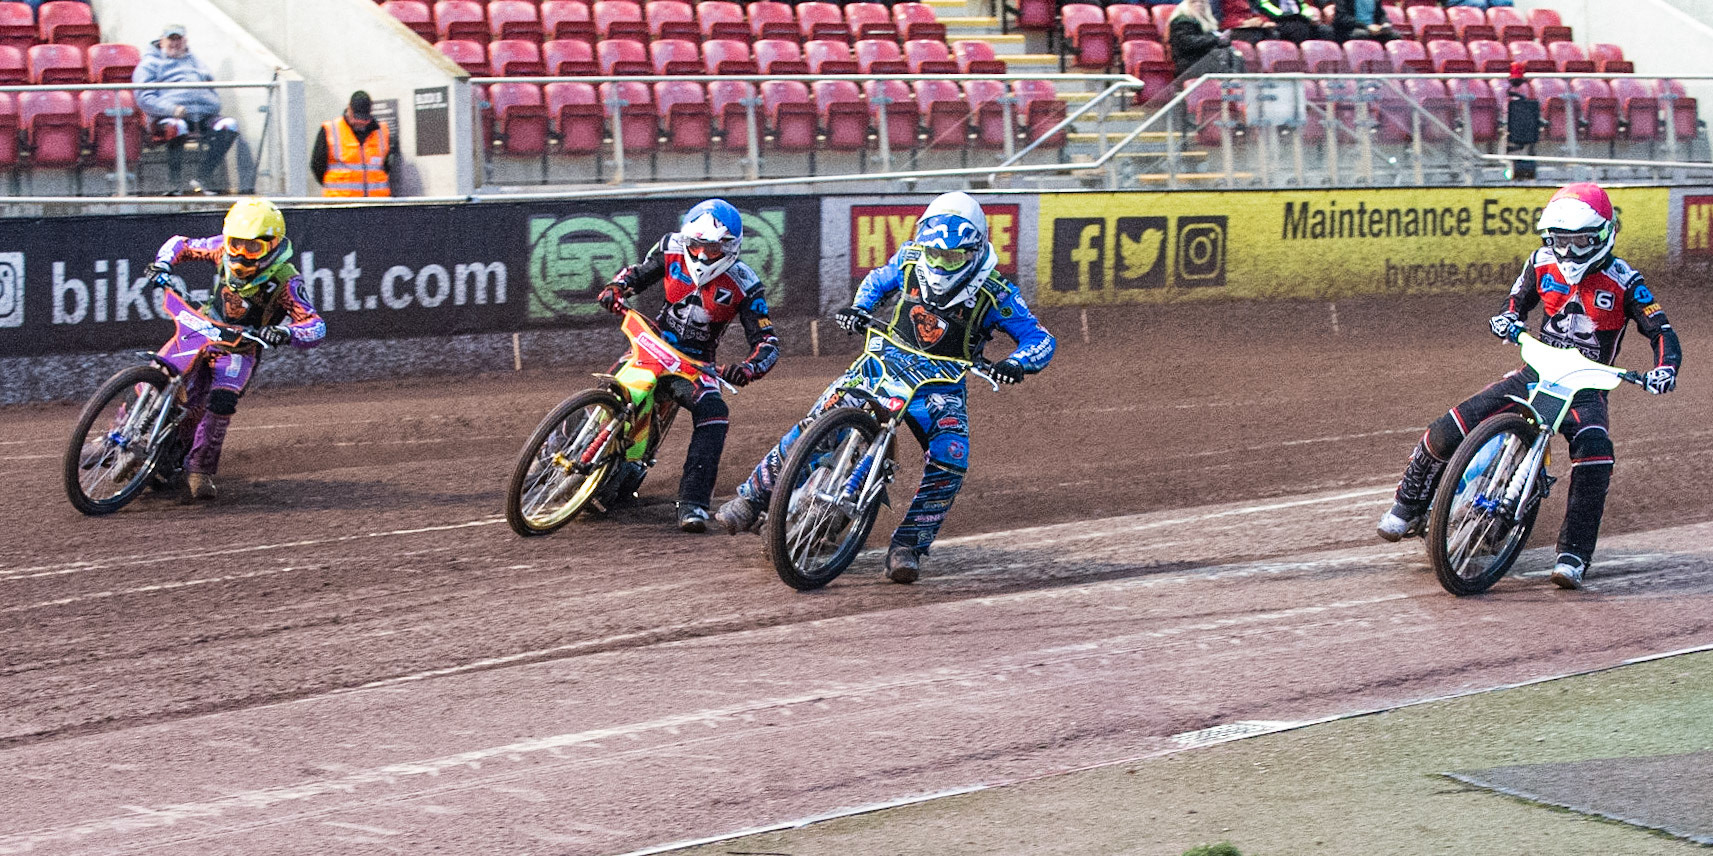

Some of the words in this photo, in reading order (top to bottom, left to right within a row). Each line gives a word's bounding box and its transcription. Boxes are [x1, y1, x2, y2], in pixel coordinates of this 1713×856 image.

[1281, 200, 1471, 240] Maintenance
[51, 250, 508, 325] bike-ht.com
[715, 288, 732, 303] 7
[1596, 292, 1613, 308] 6
